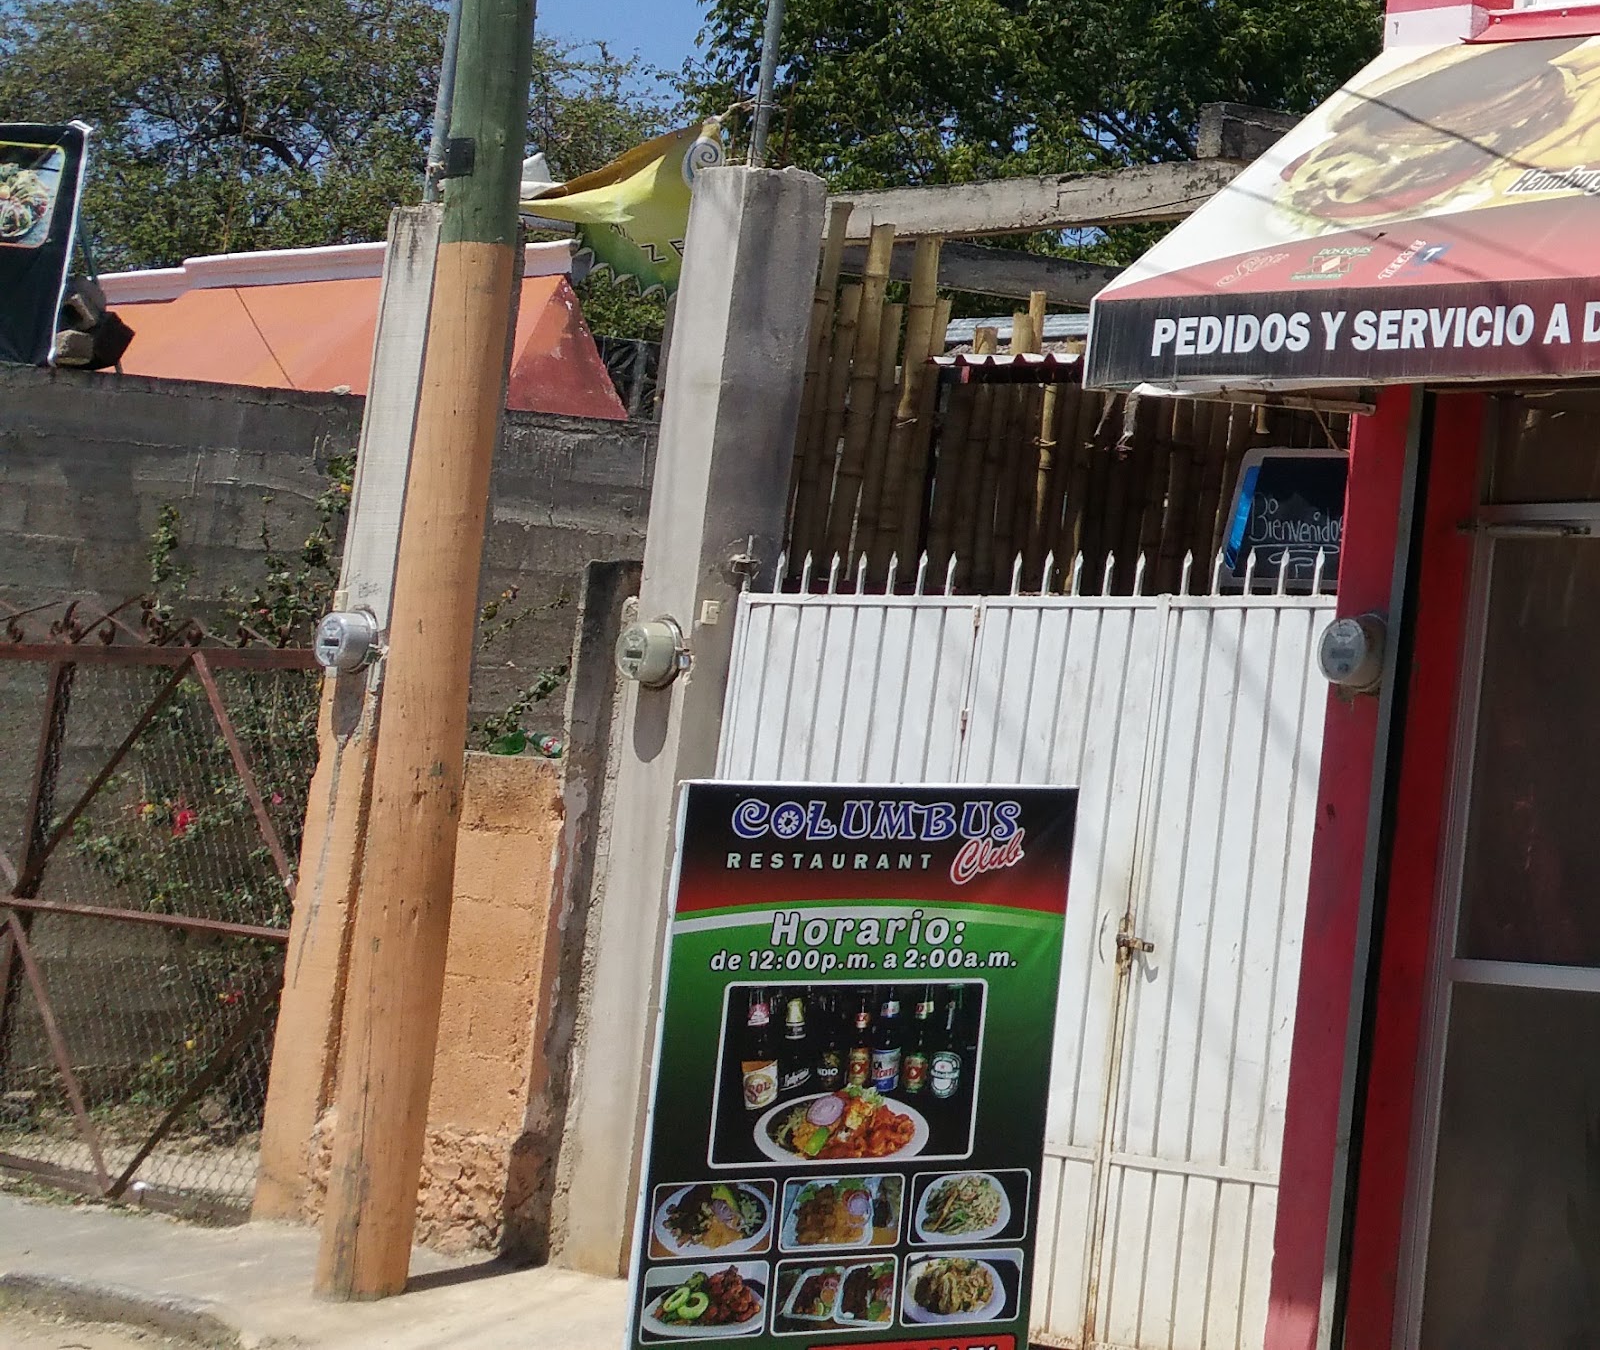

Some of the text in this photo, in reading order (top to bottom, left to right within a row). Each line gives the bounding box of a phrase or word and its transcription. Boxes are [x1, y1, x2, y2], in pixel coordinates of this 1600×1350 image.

[1151, 312, 1311, 358] PEDIDOS
[1321, 310, 1348, 350] Y
[1351, 305, 1535, 351] SERVICIO
[1543, 303, 1571, 345] A
[732, 798, 1021, 841] COLUMBUS
[726, 828, 1025, 885] RESTAURANT Club
[770, 910, 966, 946] Horario:
[710, 949, 1018, 973] de 12:00p.m. a 2:00a.m.
